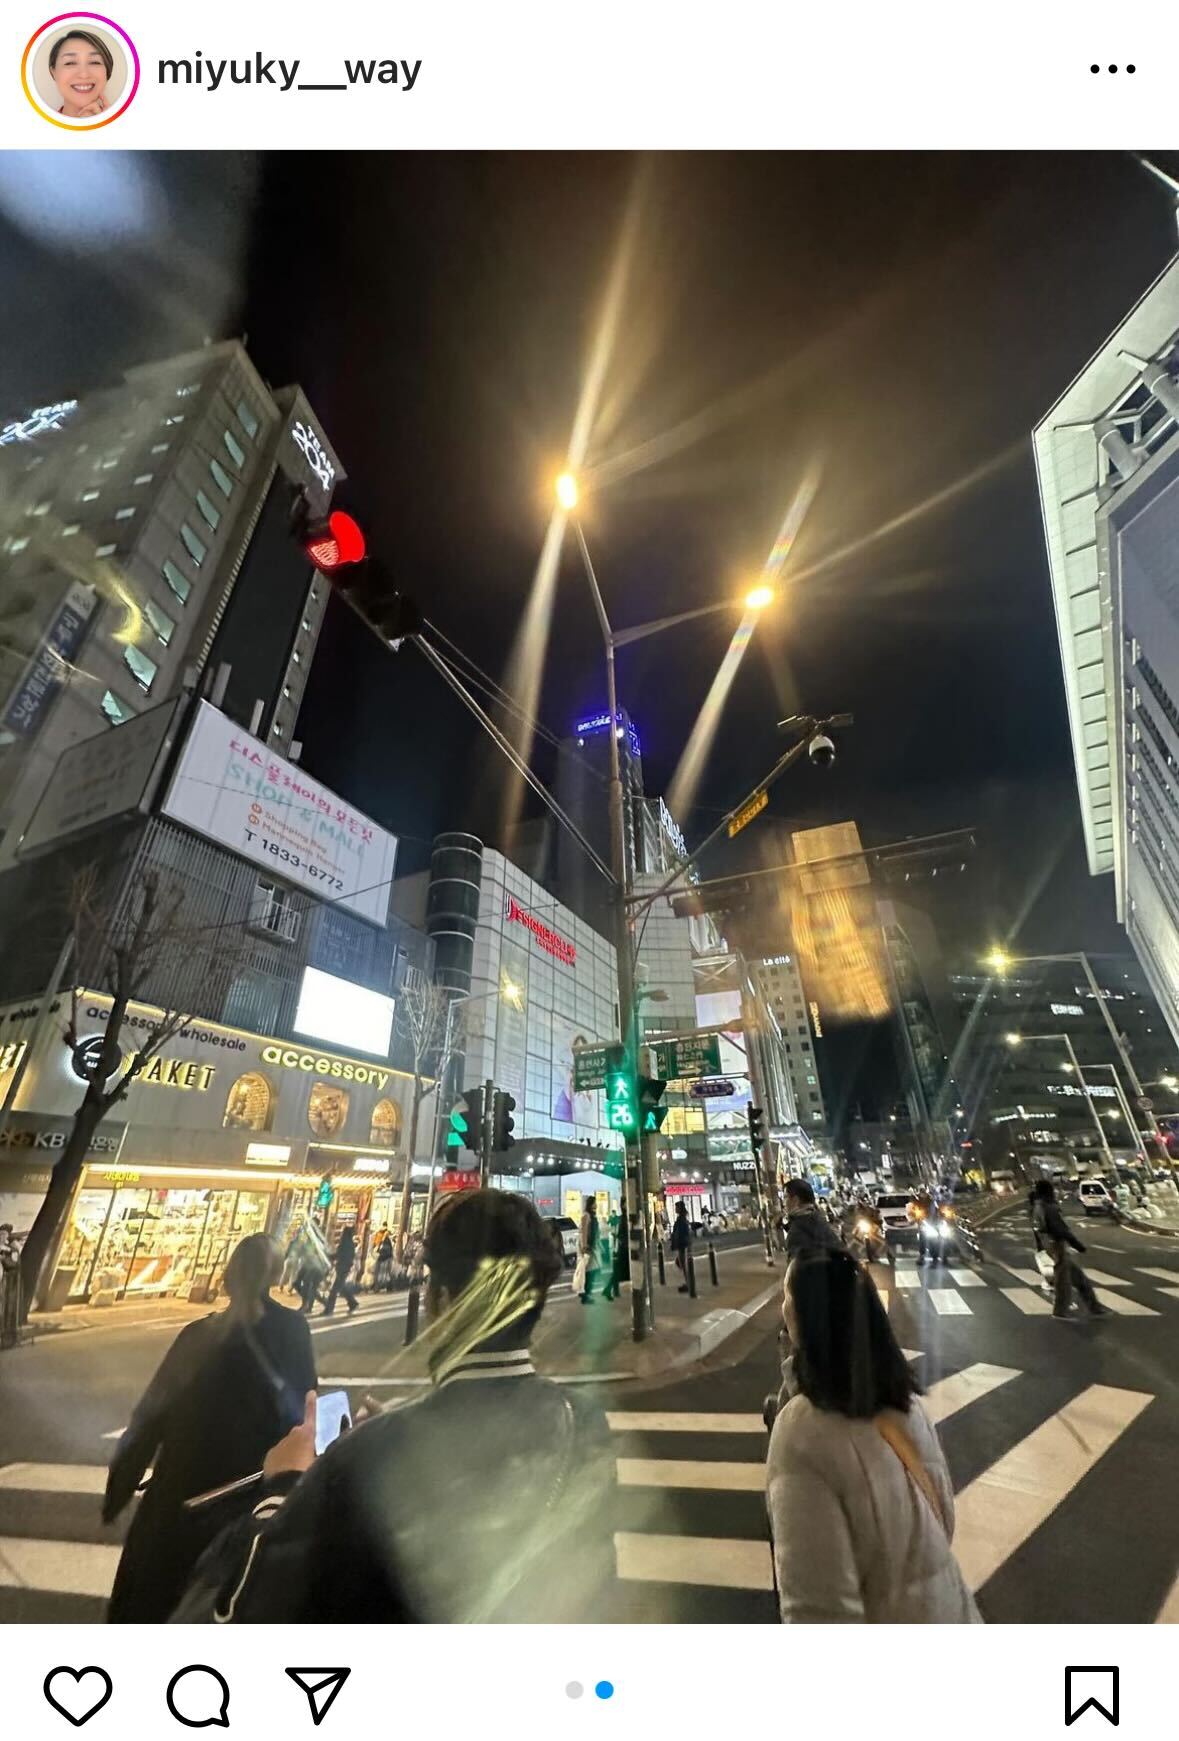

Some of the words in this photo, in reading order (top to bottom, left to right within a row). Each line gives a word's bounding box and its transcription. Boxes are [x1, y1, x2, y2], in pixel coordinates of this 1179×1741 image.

[244, 828, 258, 842] T
[262, 838, 345, 892] 1833-6772
[262, 1046, 389, 1090] accessory
[611, 1104, 633, 1126] 26
